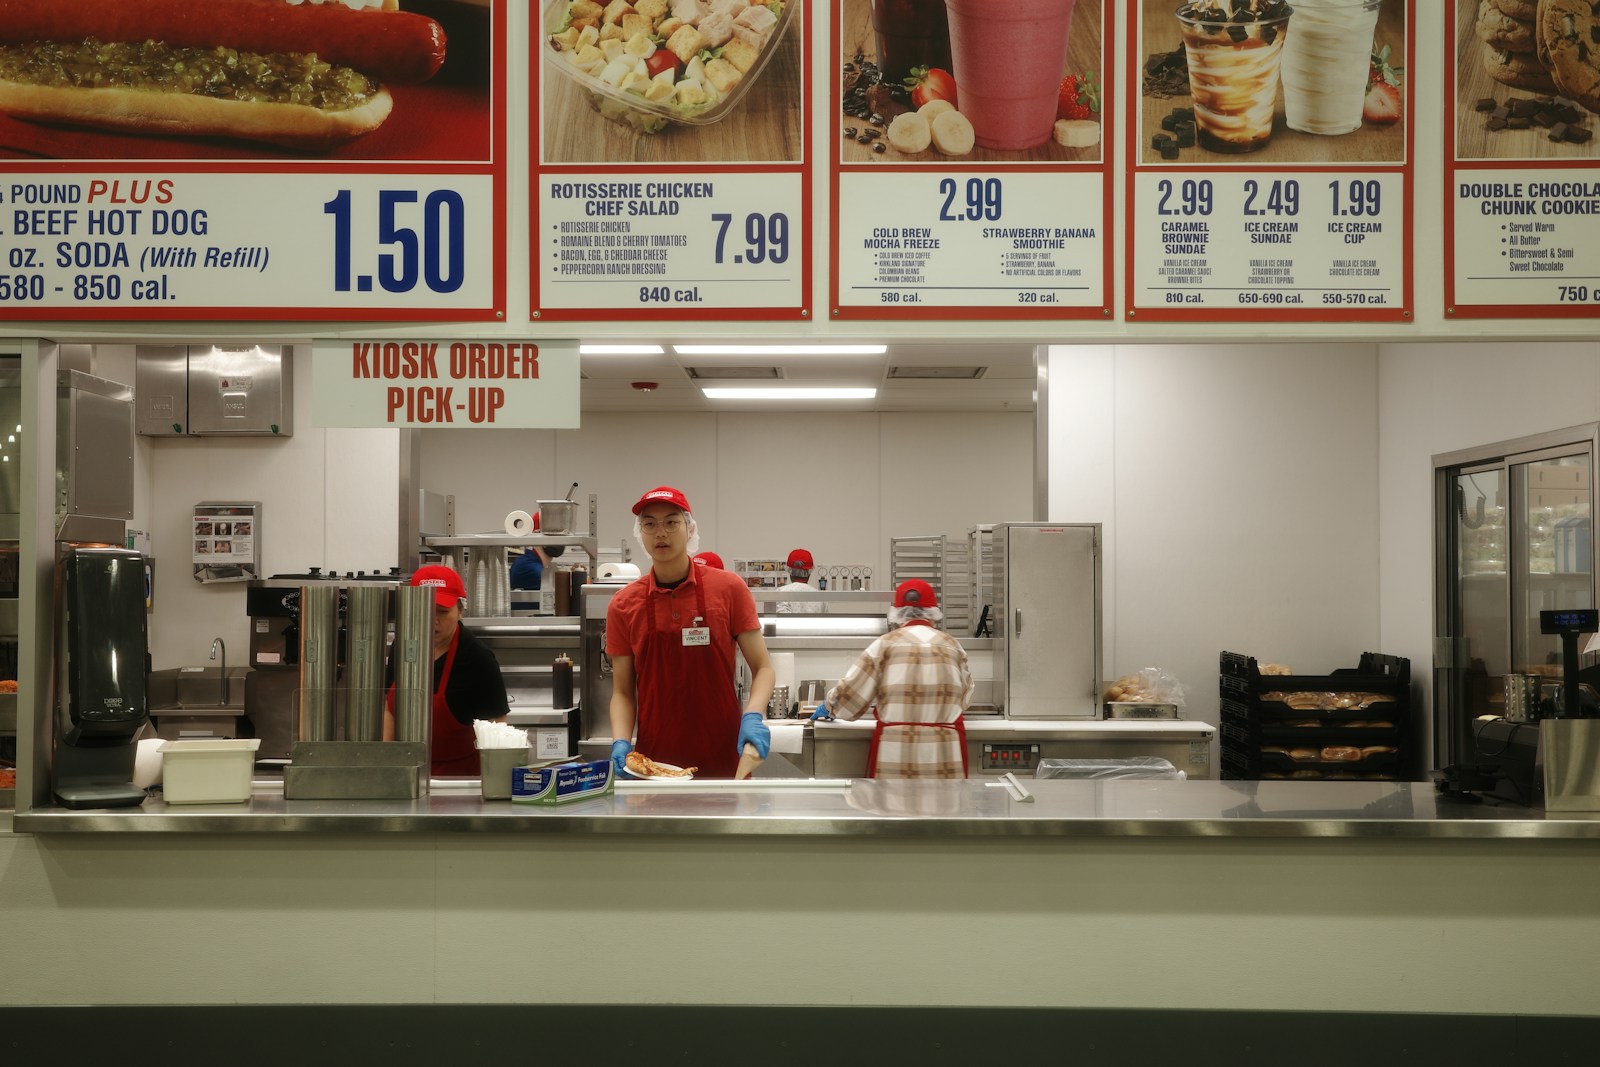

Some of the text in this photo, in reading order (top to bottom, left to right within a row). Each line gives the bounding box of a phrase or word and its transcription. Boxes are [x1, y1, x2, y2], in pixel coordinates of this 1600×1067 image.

[12, 184, 80, 204] POUND
[88, 180, 174, 204] PLUS
[552, 183, 713, 198] ROTISSERIE CHICKEN
[1460, 183, 1522, 198] DOUBLE
[940, 178, 1002, 221] 2.99
[1158, 180, 1213, 216] 2.99
[1244, 180, 1299, 216] 2.49
[1329, 180, 1380, 216] 1.99
[586, 201, 679, 215] CHEF SALAD
[1482, 200, 1536, 215] CHUNK
[14, 210, 207, 235] BEEF HOT DOG
[561, 222, 630, 232] ROTISSERIE CHICKEN
[1162, 222, 1209, 232] CARAMEL
[1244, 223, 1298, 232] ICE CREAM
[1328, 223, 1381, 232] ICE CREAM
[1510, 222, 1554, 232] Served Warm
[712, 213, 788, 264] 7.99
[873, 229, 931, 238] COLD BREW
[983, 229, 1095, 238] STRAWBERRY BANANA
[1162, 234, 1209, 242] BROWNIE
[1251, 234, 1291, 243] SUNDAE
[324, 190, 464, 293] 1.50
[561, 236, 593, 246] ROMAINE
[594, 236, 615, 246] BLEND
[623, 236, 648, 246] CHERRY
[650, 236, 686, 246] TOMATOES
[864, 239, 940, 248] MOCHA FREEZE
[1344, 234, 1365, 244] CUP
[1510, 236, 1540, 245] All Butter
[1013, 240, 1064, 249] SMOOTHIE
[1165, 245, 1206, 254] SUNDAE
[9, 242, 269, 272] oz. SODA (With Refill)
[561, 250, 586, 262] BACON,
[588, 250, 603, 262] EGG,
[611, 250, 642, 262] CHEDDAR
[643, 250, 667, 262] CHEESE
[1510, 248, 1573, 258] Bittersweet & Semi
[561, 264, 665, 274] PEPPERCORN RANCH DRESSING
[1510, 262, 1564, 271] Sweet Chocolate
[0, 275, 44, 300] 580
[74, 275, 120, 300] 850
[132, 275, 175, 300] cal.
[640, 287, 702, 302] 840 cal.
[881, 293, 921, 302] 580 cal.
[1018, 293, 1058, 302] 320 cal.
[1166, 293, 1203, 302] 810 cal.
[1239, 293, 1303, 303] 650-690 cal.
[1559, 286, 1587, 301] 750
[1323, 294, 1386, 304] 550-570 cal.
[353, 343, 539, 379] KIOSK ORDER
[388, 386, 504, 423] PICK-UP
